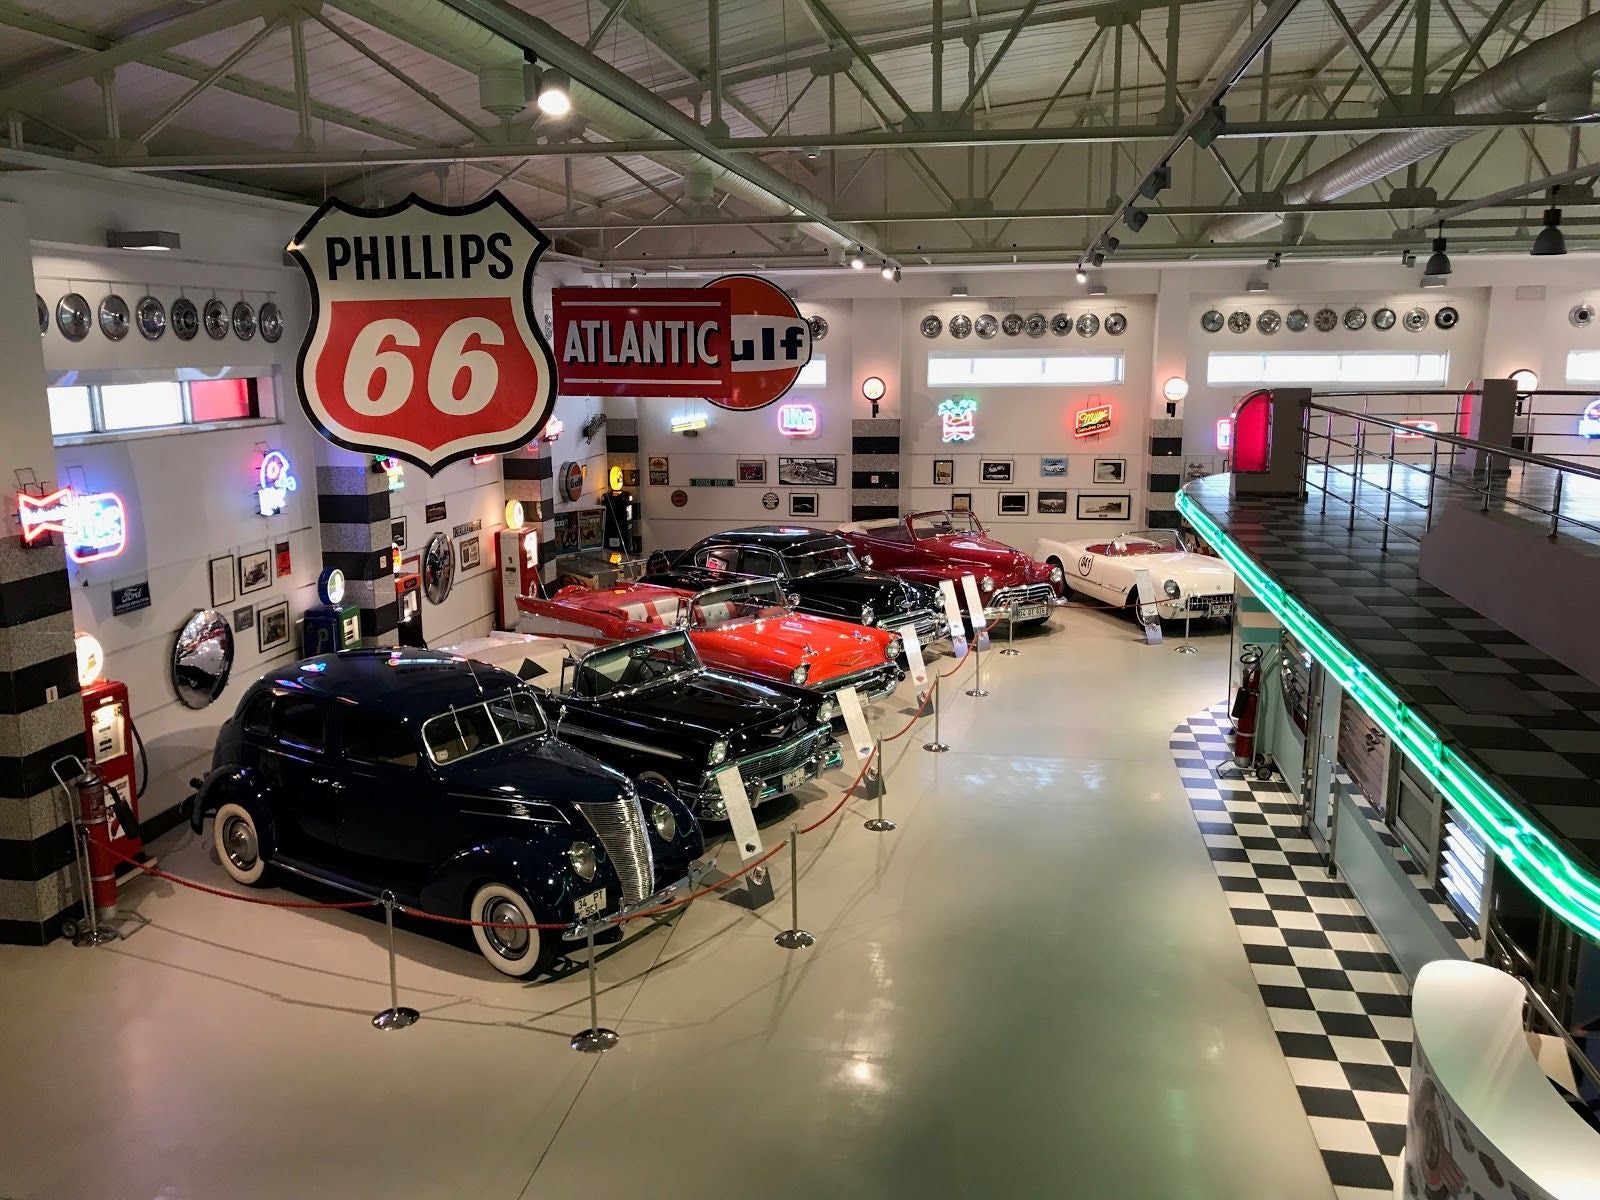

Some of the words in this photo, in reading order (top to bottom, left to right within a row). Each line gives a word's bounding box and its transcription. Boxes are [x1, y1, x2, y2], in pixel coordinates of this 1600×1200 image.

[326, 232, 513, 280] PHILLIPS
[342, 317, 506, 417] 66
[562, 319, 721, 367] ATLANTIC
[731, 326, 804, 361] ulf
[578, 898, 587, 910] 34
